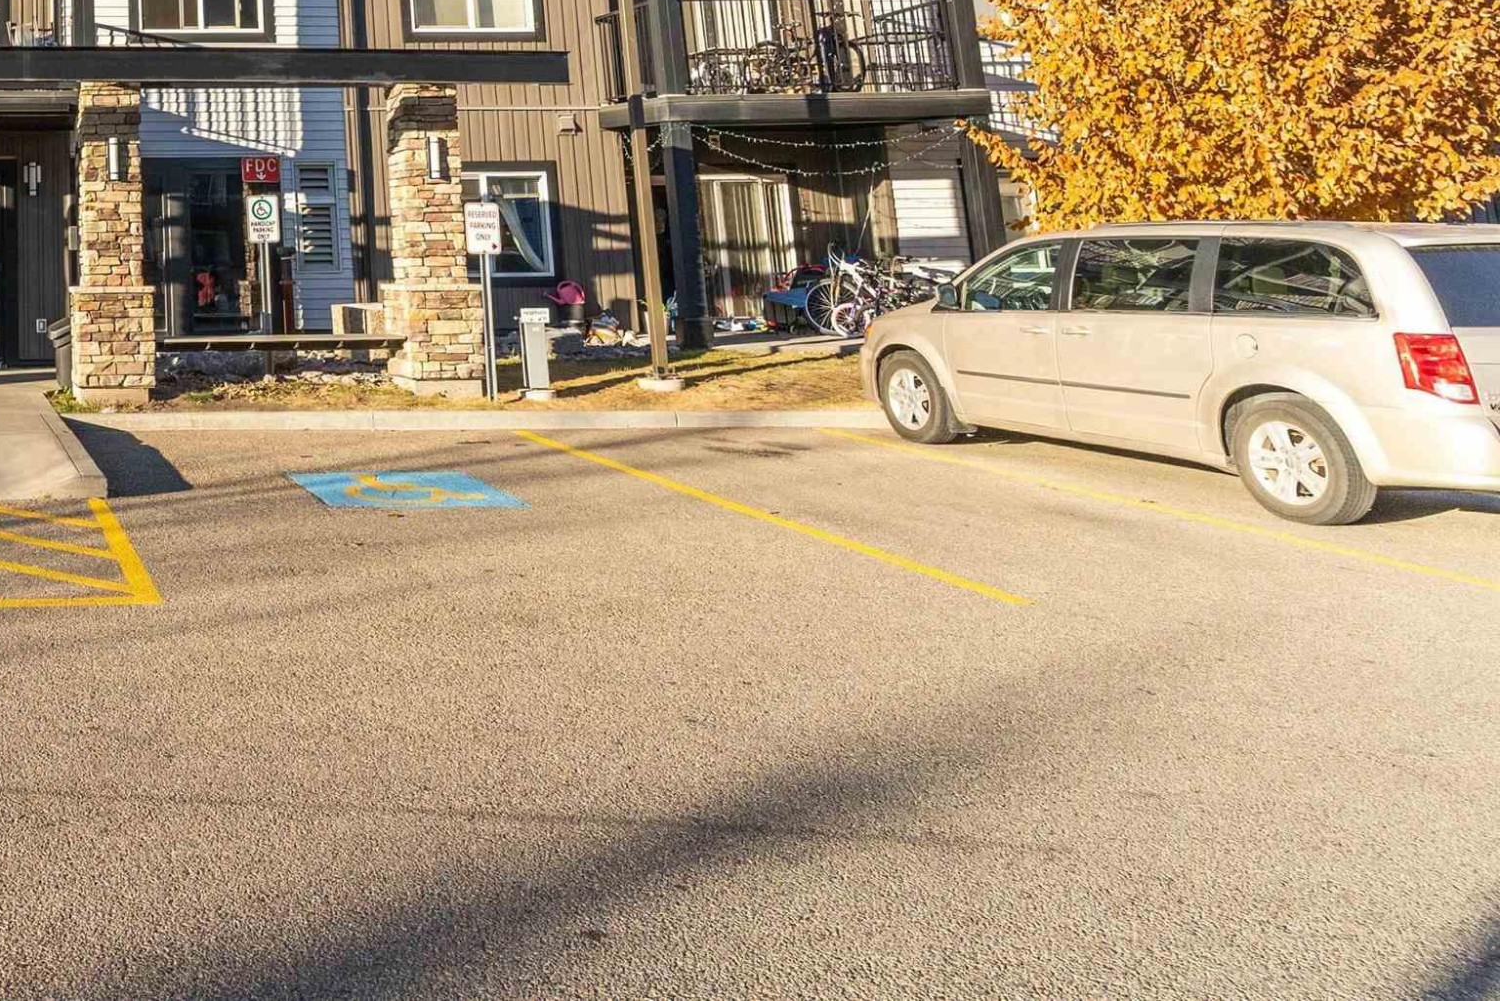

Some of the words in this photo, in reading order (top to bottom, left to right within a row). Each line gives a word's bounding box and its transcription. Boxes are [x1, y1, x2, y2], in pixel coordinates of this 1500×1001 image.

[245, 158, 277, 173] FDC
[467, 210, 497, 219] RESERVED
[469, 221, 496, 230] PARKING
[475, 233, 491, 241] ONLY
